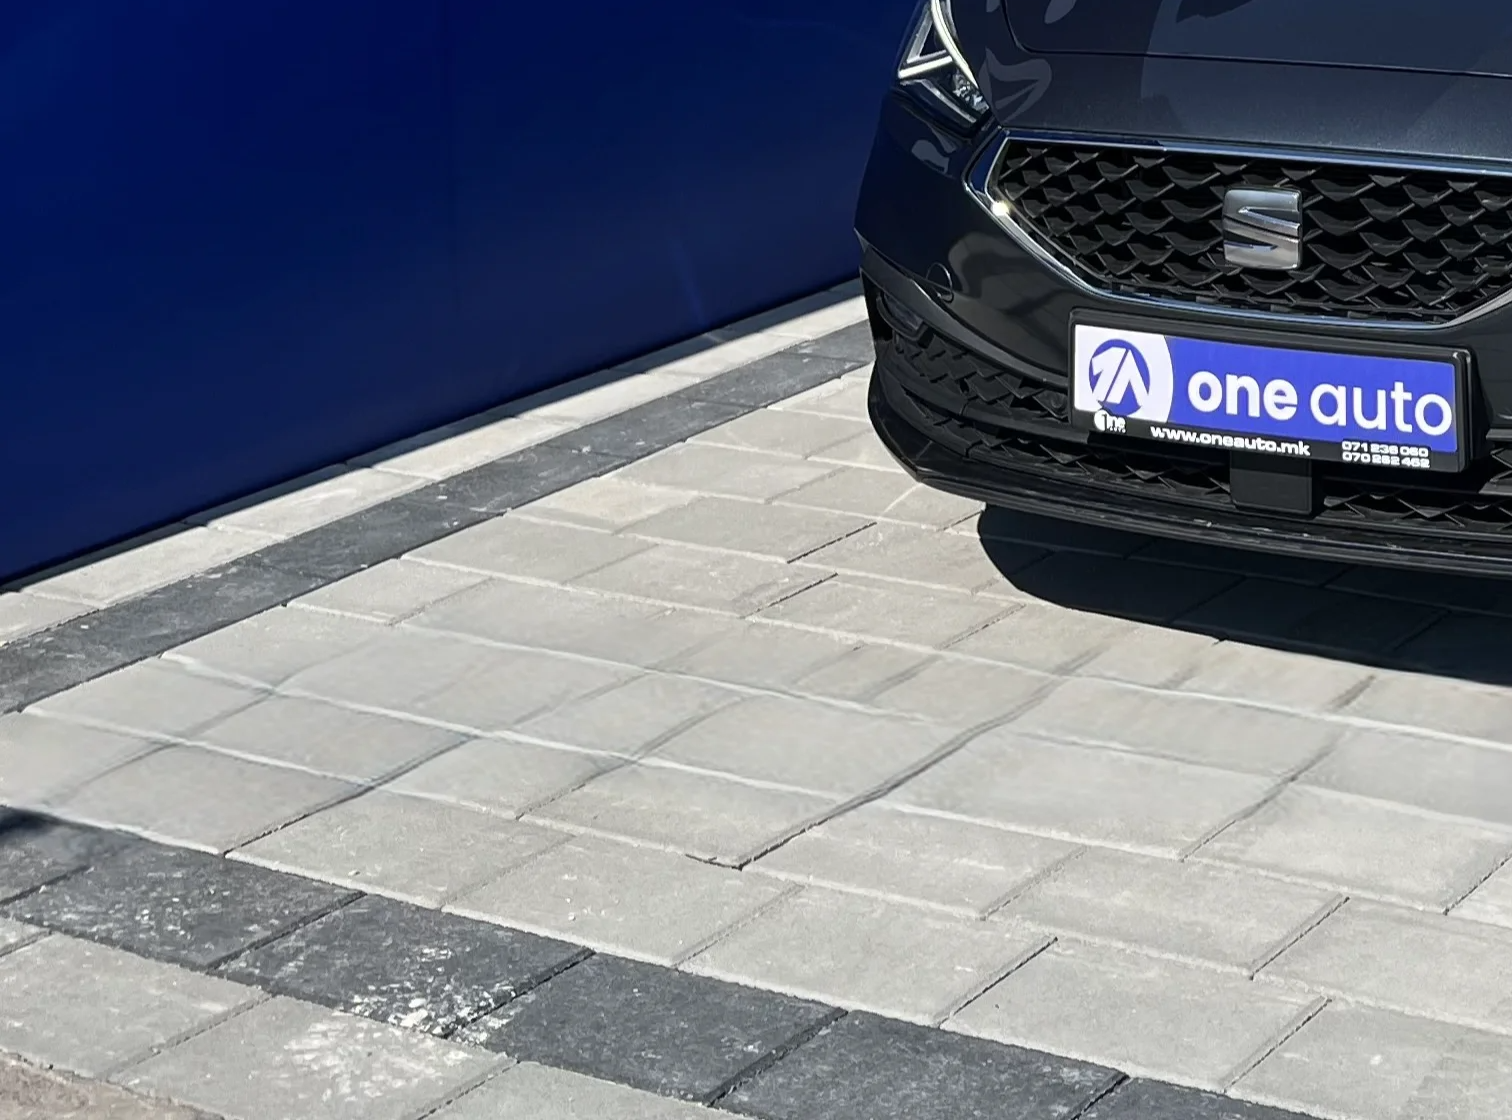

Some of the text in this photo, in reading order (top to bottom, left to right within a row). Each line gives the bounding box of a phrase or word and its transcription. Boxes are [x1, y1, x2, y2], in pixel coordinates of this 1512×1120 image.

[1187, 371, 1453, 436] one auto
[1149, 425, 1311, 457] www.oneauto.mk
[1341, 440, 1369, 453] 071
[1341, 451, 1371, 464] 070
